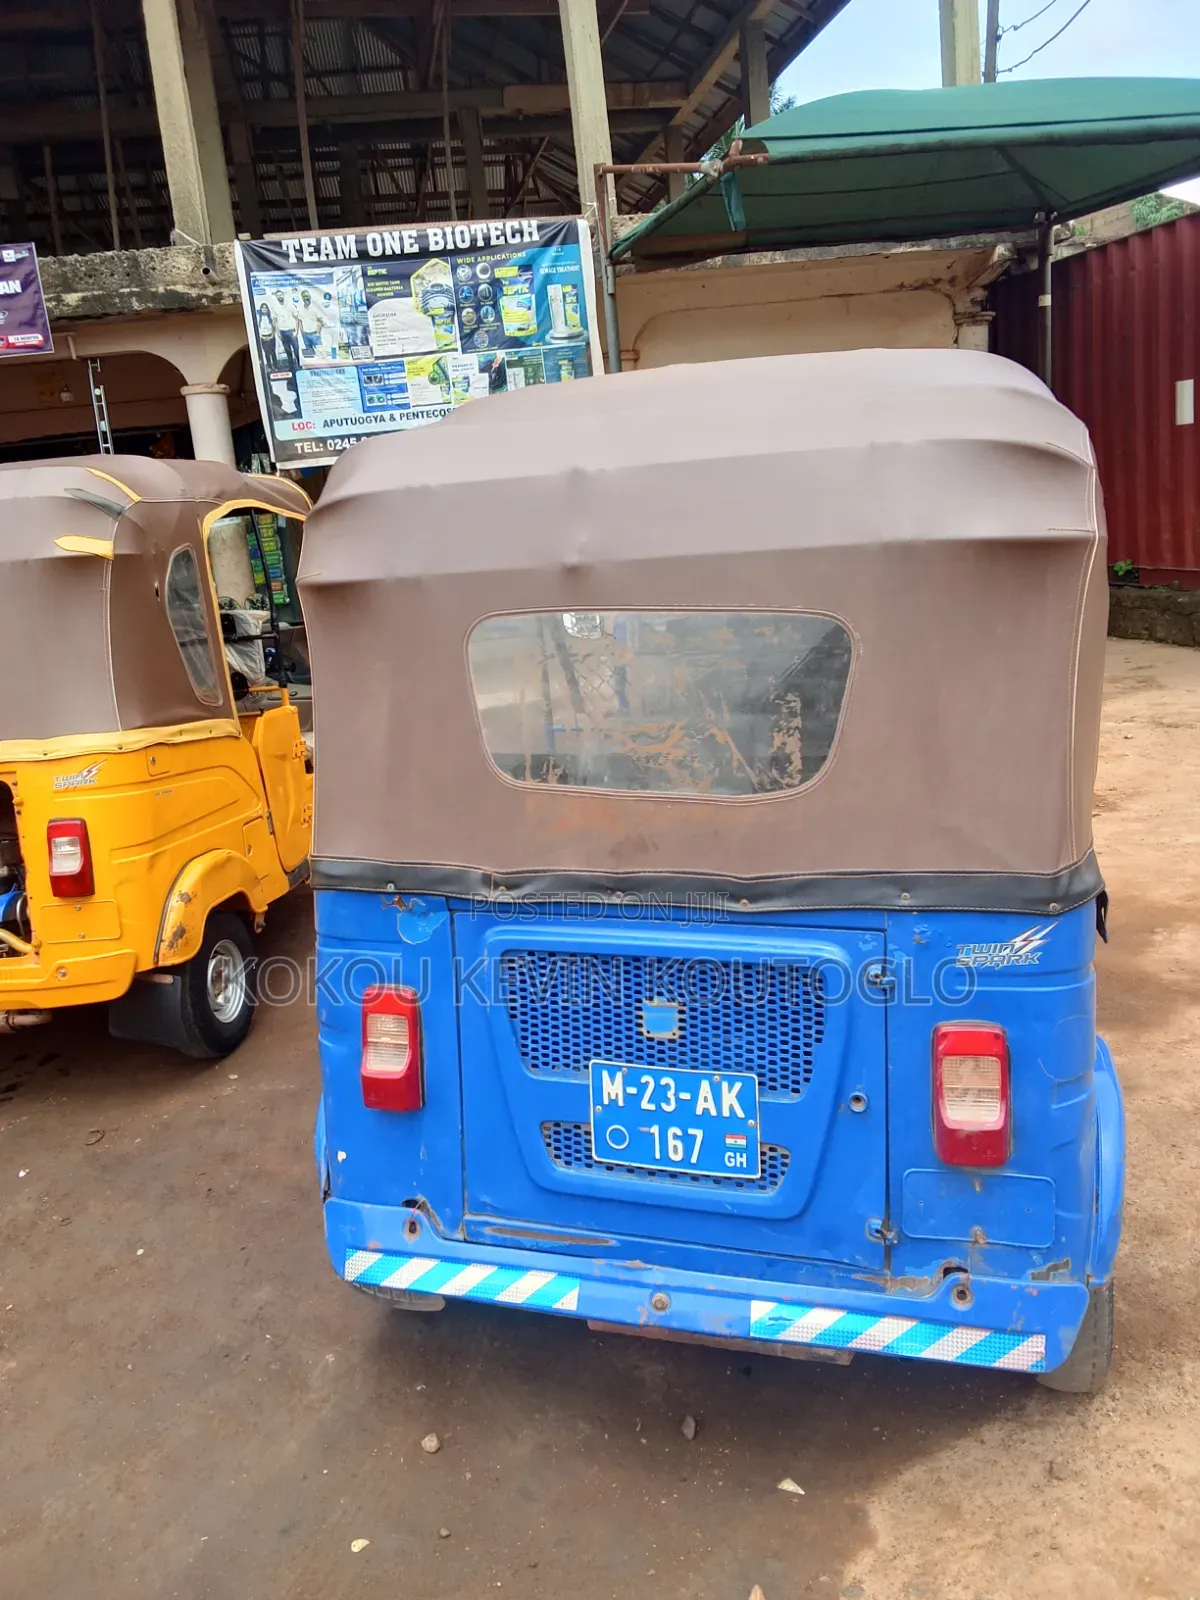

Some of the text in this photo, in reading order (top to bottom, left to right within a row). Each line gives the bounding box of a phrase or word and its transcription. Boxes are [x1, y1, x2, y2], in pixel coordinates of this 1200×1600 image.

[281, 219, 541, 263] TEAM ONE BIOTECH
[456, 251, 527, 264] WIDE APPLICATIONS
[292, 421, 316, 432] LOC:
[323, 414, 386, 429] APUTUOGYA
[389, 413, 397, 422] &
[294, 439, 324, 454] TEL:
[955, 952, 1042, 968] SPARK
[601, 1069, 746, 1119] M-23-AK
[649, 1124, 704, 1164] 167
[724, 1151, 748, 1168] GH
